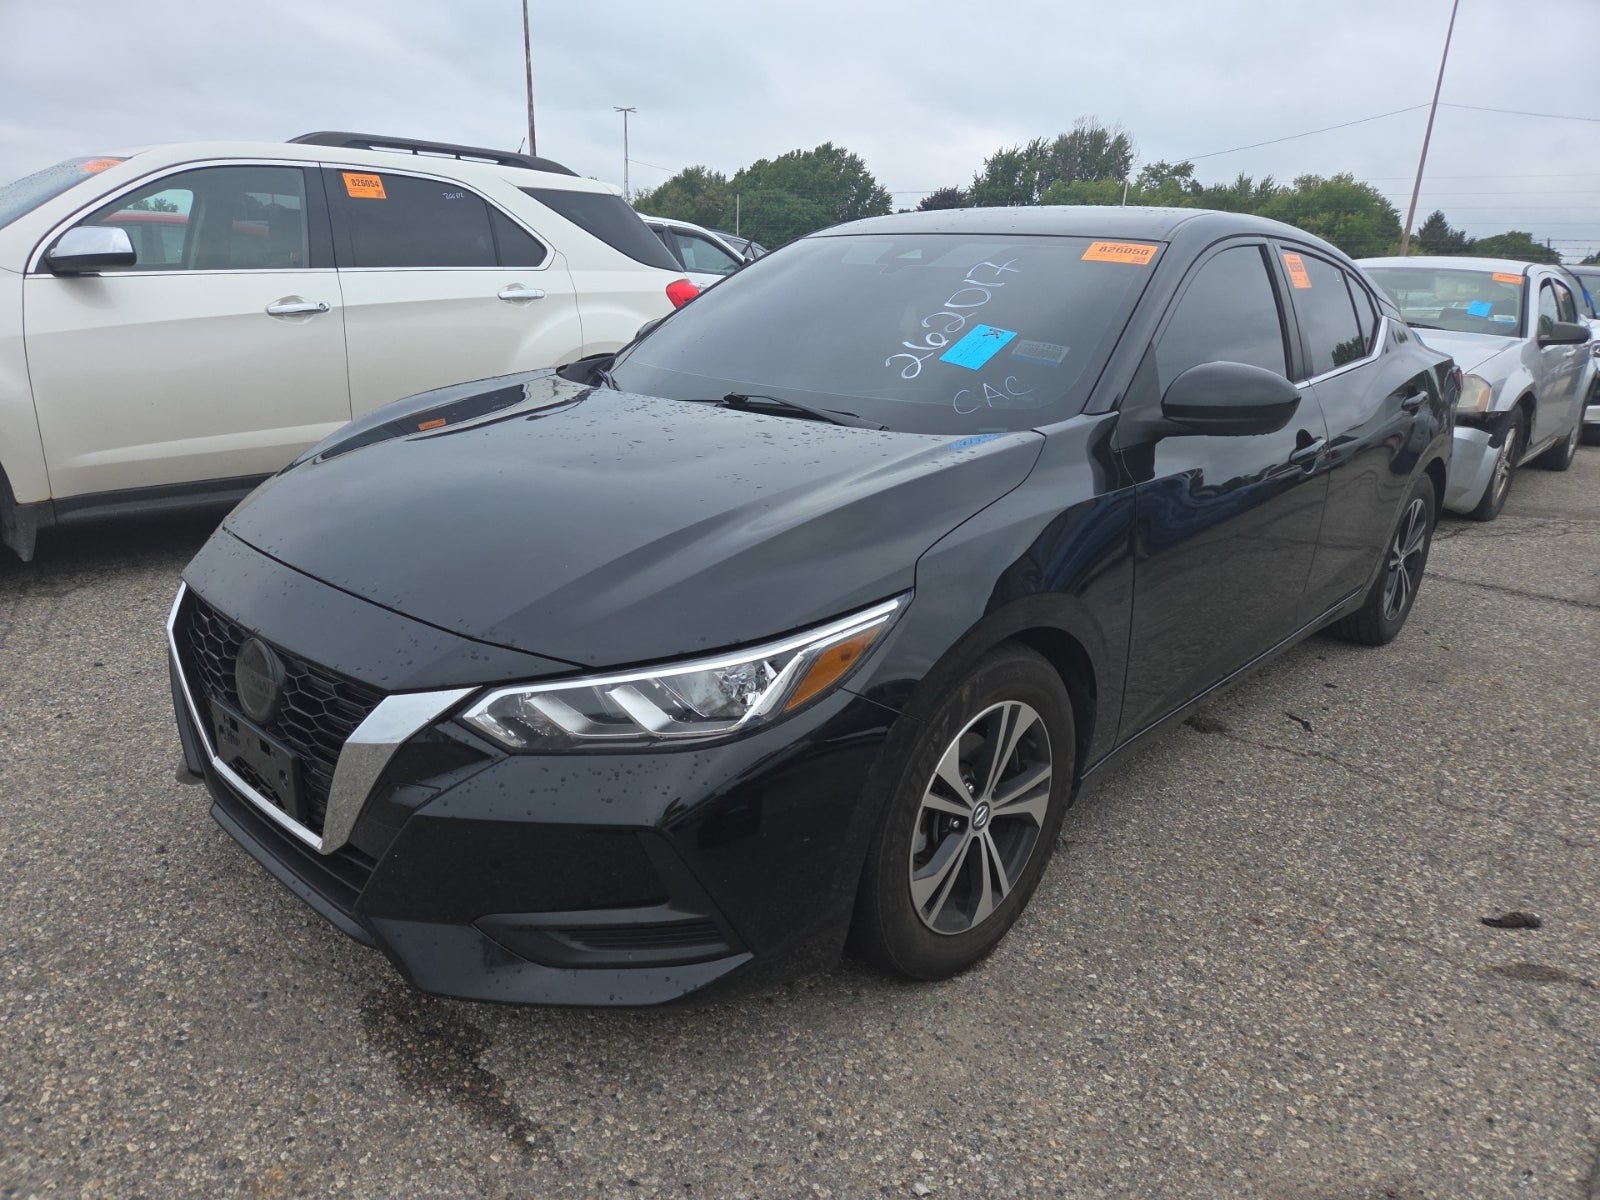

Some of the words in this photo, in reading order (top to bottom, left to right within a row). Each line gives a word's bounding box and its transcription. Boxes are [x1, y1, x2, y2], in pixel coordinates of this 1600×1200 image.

[351, 178, 380, 188] 826054
[1099, 246, 1149, 256] 826050
[953, 375, 1037, 414] CAC
